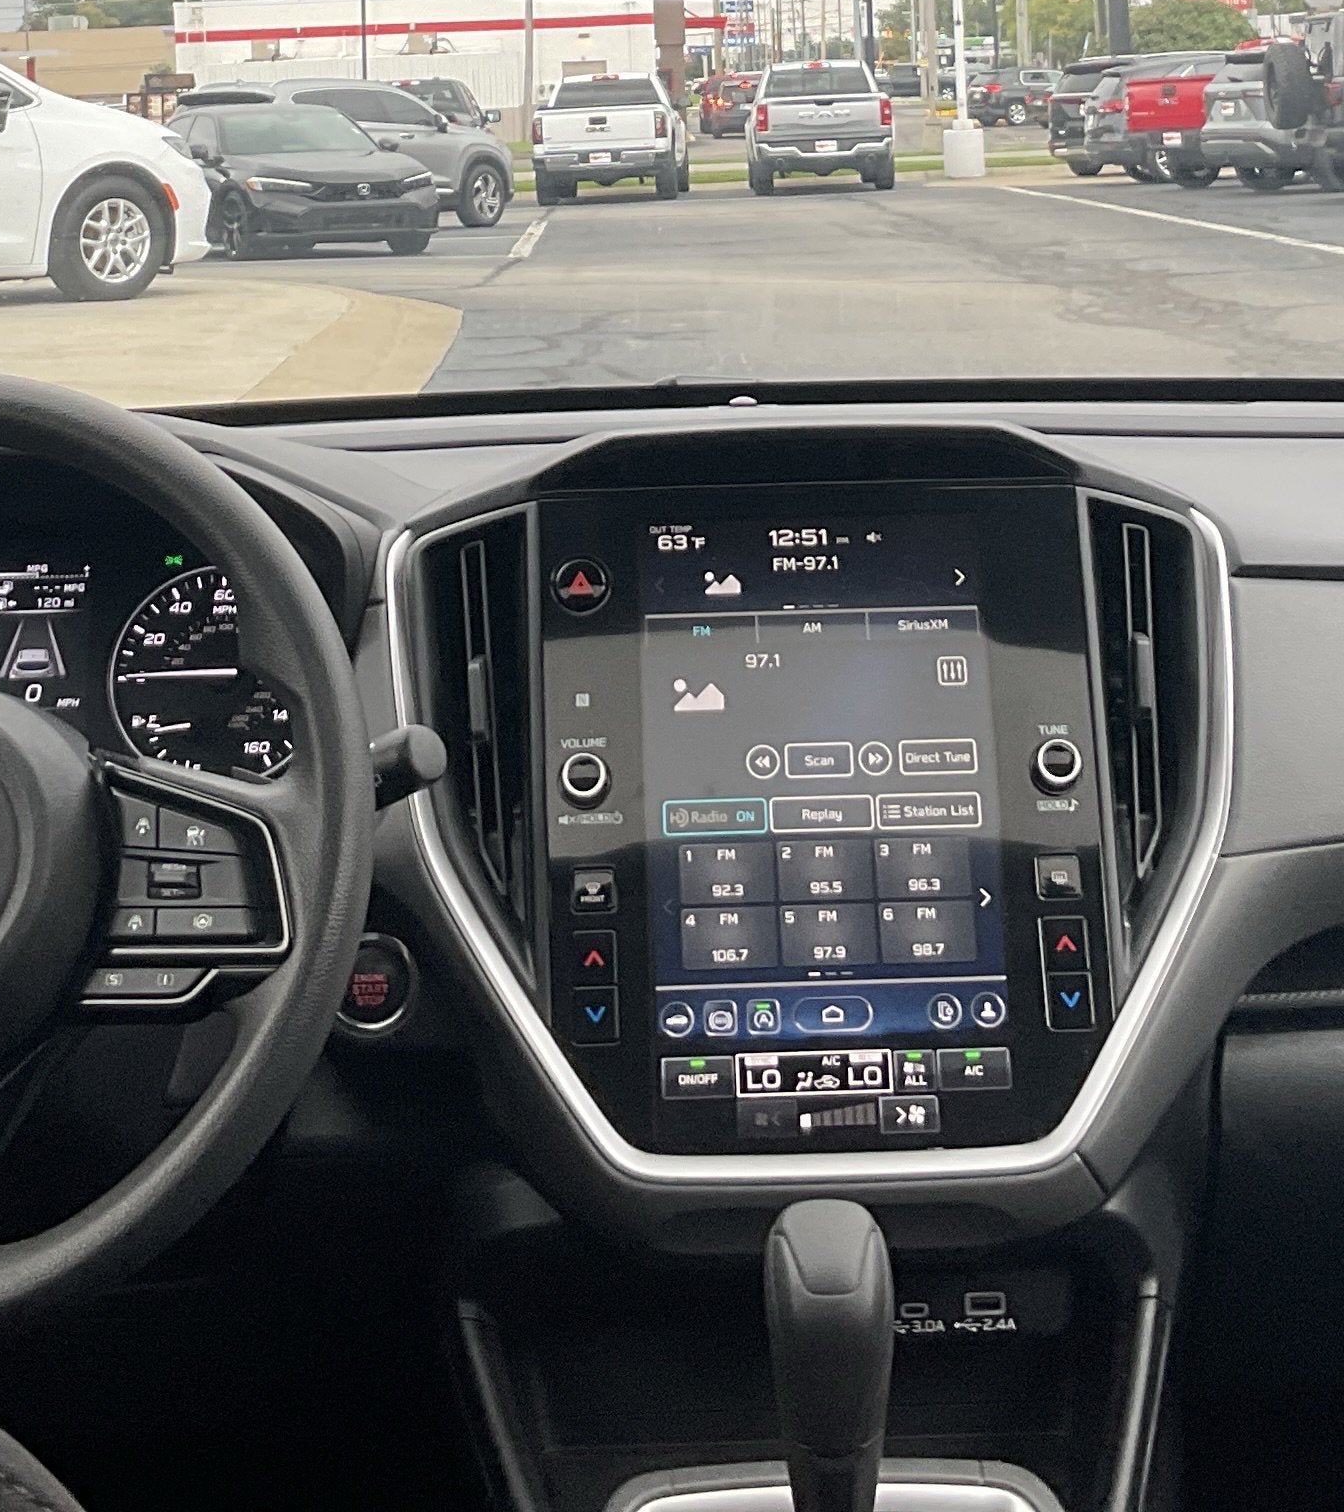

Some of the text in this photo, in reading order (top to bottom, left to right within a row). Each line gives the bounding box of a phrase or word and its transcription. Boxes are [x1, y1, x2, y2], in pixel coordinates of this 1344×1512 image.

[797, 109, 852, 119] RAM
[585, 124, 611, 133] GMC
[649, 524, 693, 534] OUT TEMP
[657, 534, 688, 551] 63
[768, 528, 828, 547] 12:51
[772, 555, 839, 572] FM-97.1
[36, 597, 61, 608] 120
[169, 601, 192, 614] 40
[212, 605, 237, 615] MPH
[692, 624, 713, 637] FM
[802, 621, 822, 634] AM
[897, 618, 949, 632] SiriusXM
[143, 632, 166, 646] 20
[744, 653, 781, 669] 97.1
[25, 683, 43, 703] 0
[56, 697, 81, 708] MPH
[272, 709, 288, 722] 14
[1038, 724, 1069, 735] TUNE
[243, 741, 271, 754] 160
[560, 737, 607, 749] VOLUME
[804, 754, 834, 767] Scan
[905, 750, 971, 765] Direct Tune
[903, 802, 974, 818] Station List
[1036, 799, 1069, 811] HOLD
[690, 809, 728, 823] Radio
[735, 809, 755, 823] ON
[801, 807, 843, 823] Replay
[686, 849, 736, 862] 1 FM
[781, 845, 834, 859] 2 FM
[879, 843, 932, 856] 3 FM
[711, 883, 745, 897] 92.3
[809, 881, 843, 894] 95.5
[908, 878, 941, 891] 96.3
[685, 913, 739, 927] 4 FM
[784, 910, 838, 923] 5 FM
[883, 907, 936, 921] 6 FM
[711, 948, 749, 962] 106.7
[813, 946, 847, 959] 97.9
[912, 943, 945, 956] 98.7
[351, 983, 389, 995] START
[821, 1055, 841, 1066] A/C
[847, 1065, 883, 1087] LO
[964, 1065, 985, 1077] A/C
[677, 1072, 719, 1086] ON/OFF
[746, 1068, 782, 1090] LO
[904, 1075, 928, 1087] ALL
